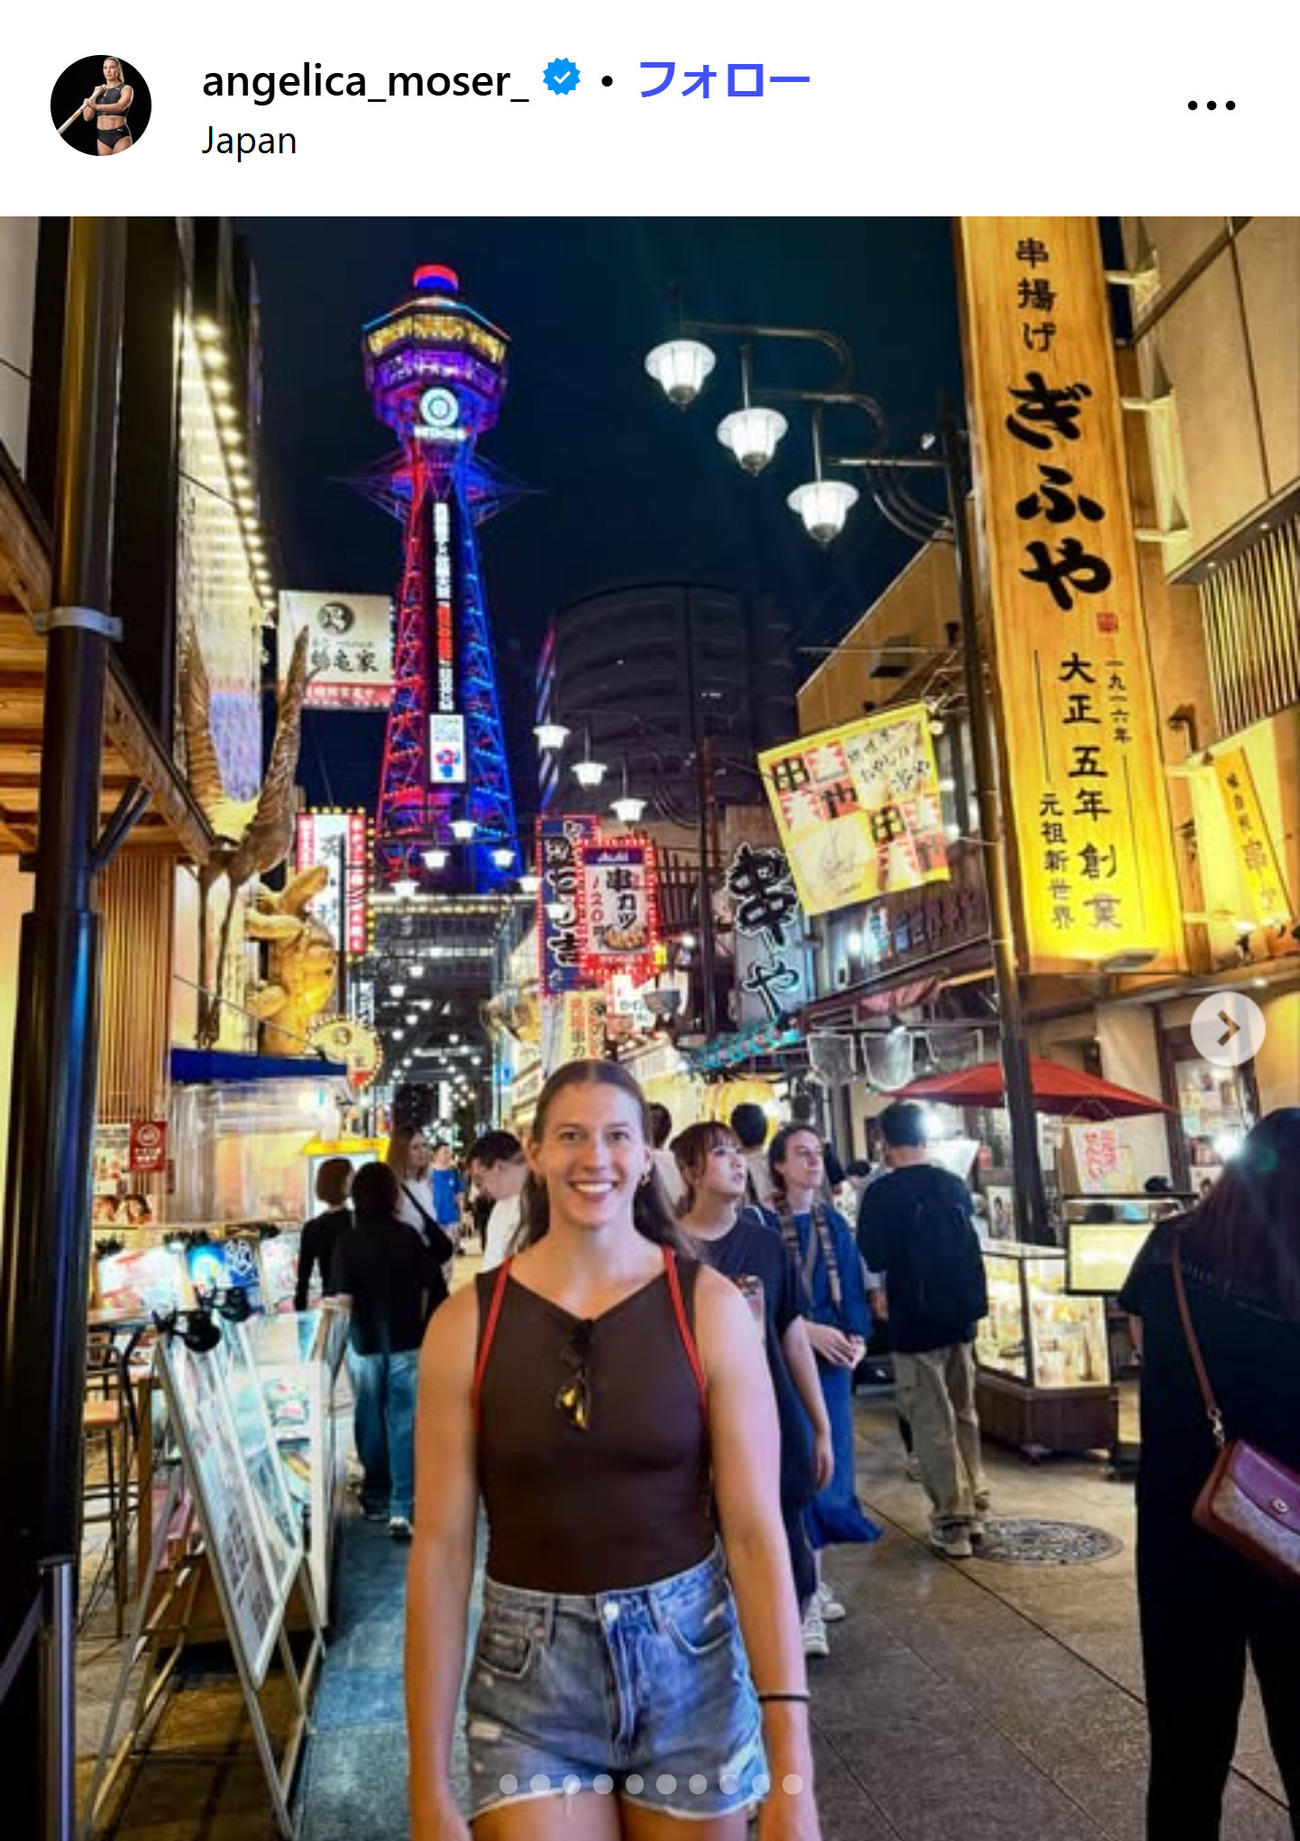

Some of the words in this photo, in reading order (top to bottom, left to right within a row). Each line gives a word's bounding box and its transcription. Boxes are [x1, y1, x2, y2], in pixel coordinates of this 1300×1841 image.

[1016, 237, 1057, 353] 串揚げ
[1006, 371, 1112, 611] ぎふや
[1104, 660, 1131, 744] 一九一六年
[1058, 652, 1123, 930] 大正五年創業
[1038, 793, 1075, 930] 元祖新世界
